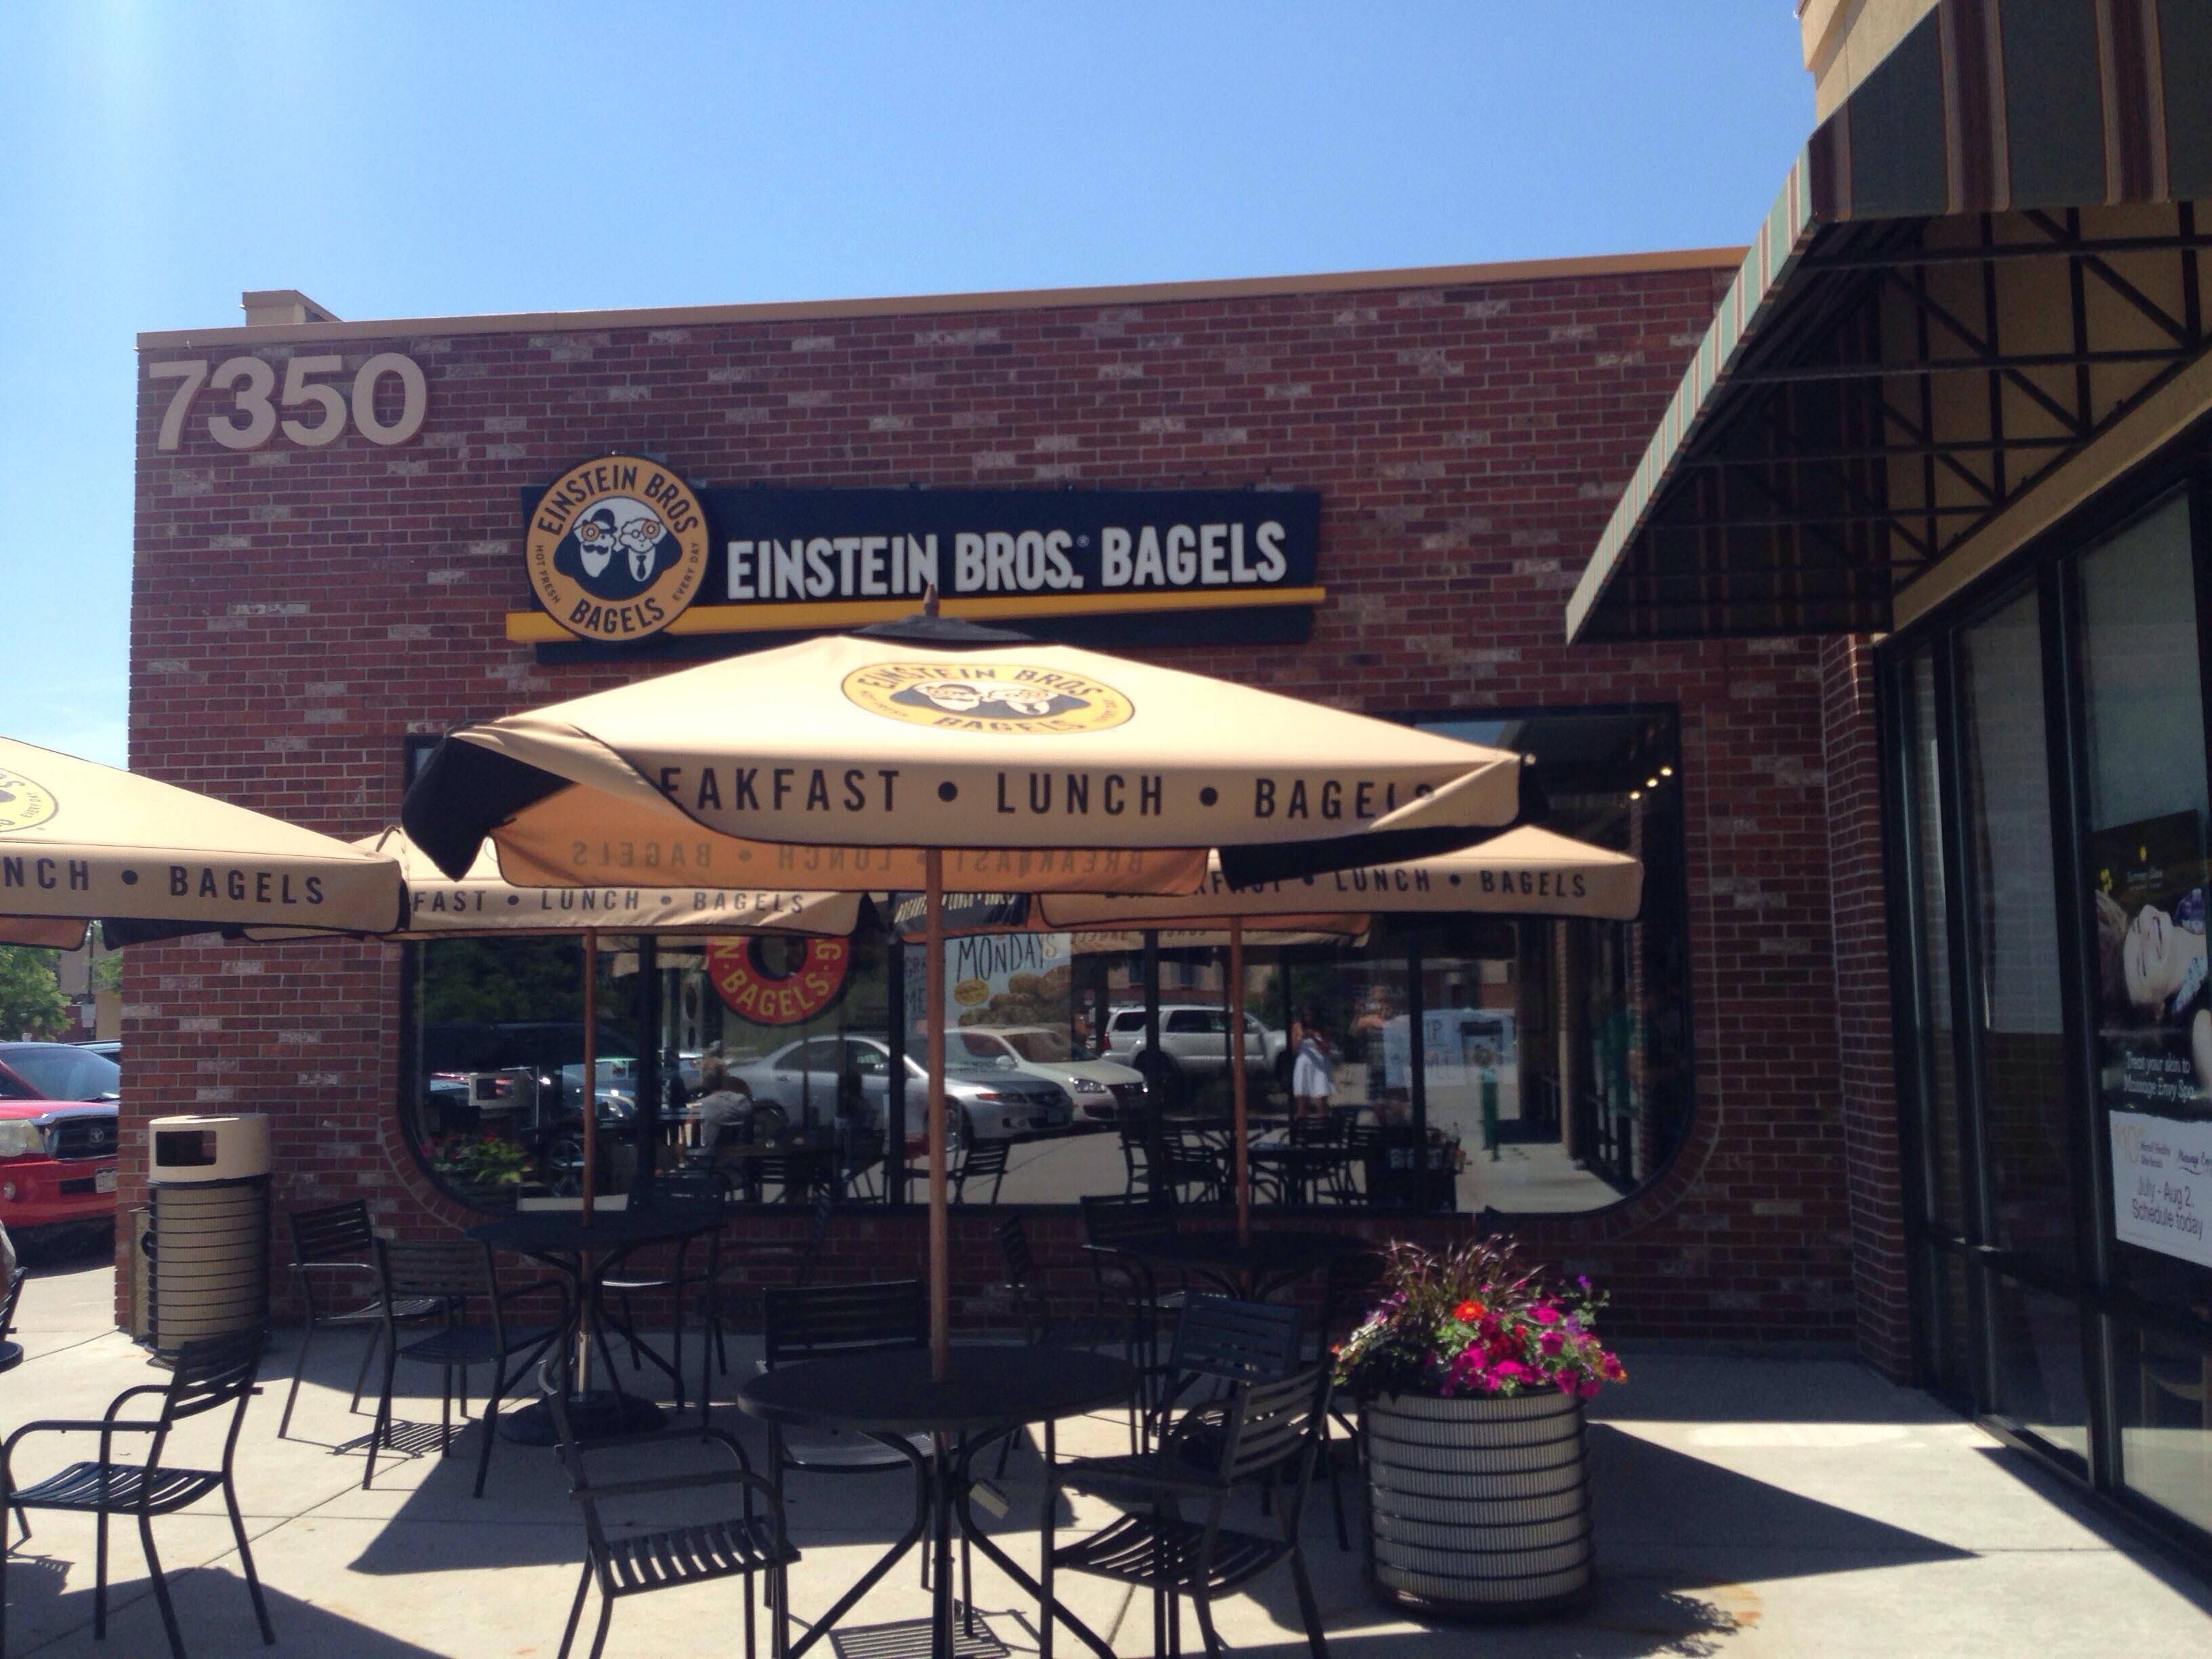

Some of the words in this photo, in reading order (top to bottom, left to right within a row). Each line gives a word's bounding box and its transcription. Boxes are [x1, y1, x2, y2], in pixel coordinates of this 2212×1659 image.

[149, 352, 428, 452] 7350
[537, 464, 638, 536] EINSTEIN
[644, 472, 699, 533] BROS
[535, 544, 546, 567] HOT
[672, 567, 696, 602] EVERY
[690, 543, 700, 563] DAY
[727, 533, 939, 600] EINSTEIN
[1101, 521, 1287, 587] BAGELS
[539, 569, 562, 605] FRESH
[569, 597, 665, 634] BAGELS
[1014, 670, 1103, 695] BROS
[997, 773, 1163, 815] LUNCH
[3, 856, 89, 890] NCH
[169, 865, 324, 904] BAGELS
[1335, 869, 1430, 893] LUNCH
[1480, 870, 1586, 897] BAGELS
[413, 890, 486, 912] FAST
[542, 889, 640, 912] LUNCH
[693, 893, 804, 914] BAGELS
[721, 969, 829, 1017] BAGELS
[2146, 1058, 2164, 1076] your
[2182, 1057, 2190, 1073] to
[2137, 1176, 2155, 1204] July
[2164, 1182, 2183, 1210] Aug
[2132, 1198, 2174, 1229] Schedule
[2175, 1212, 2203, 1242] today
